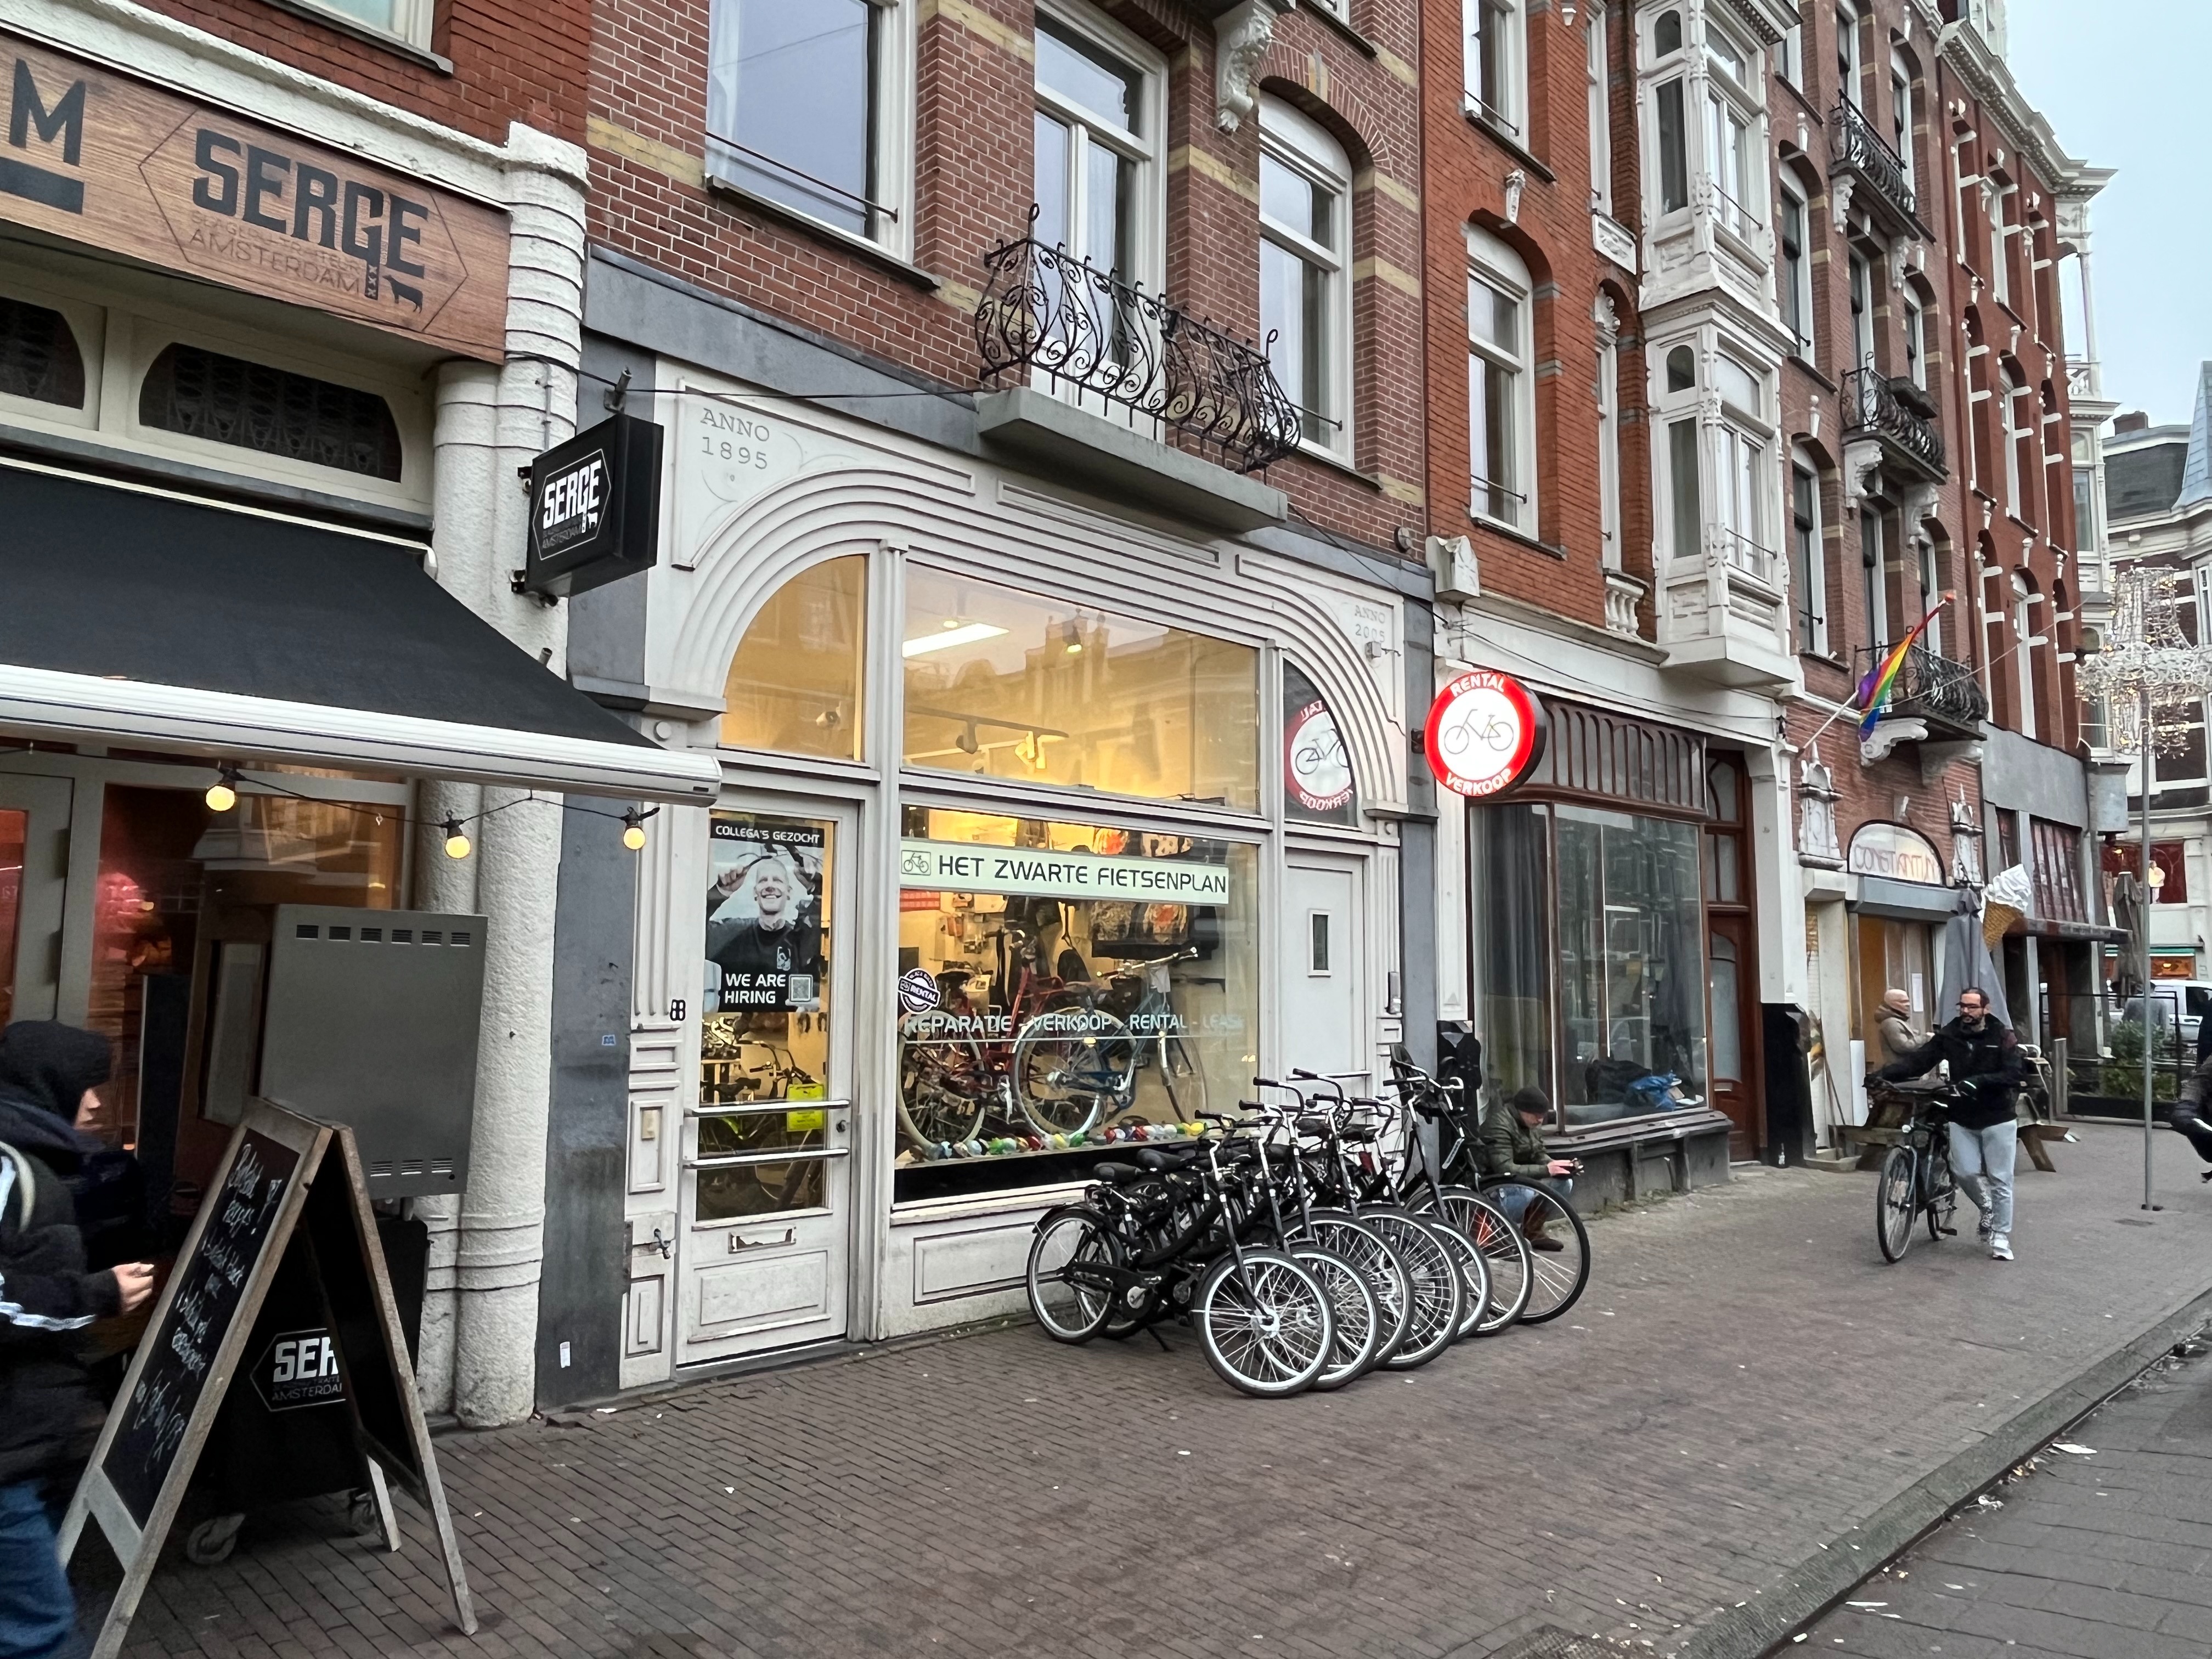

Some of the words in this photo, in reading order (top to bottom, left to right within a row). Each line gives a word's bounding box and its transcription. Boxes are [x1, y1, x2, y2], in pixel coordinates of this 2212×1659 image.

[193, 128, 428, 296] SERGE
[190, 228, 359, 294] AMSTERDAM
[700, 408, 770, 442] ANNO
[702, 437, 768, 470] 1895
[543, 459, 602, 531] SERGE
[1355, 605, 1385, 624] ANNO
[1450, 672, 1505, 697] RENTAL
[1446, 768, 1513, 797] VERKOOP
[715, 825, 769, 840] COLLEGA'S
[772, 831, 820, 844] GEZOCHT
[939, 855, 985, 877] HET
[995, 859, 1088, 884] ZWARTE
[1097, 867, 1226, 894] FIETSENPLAN
[725, 973, 751, 987] WE
[755, 973, 786, 988] ARE
[670, 999, 686, 1021] 88
[724, 990, 776, 1005] HIRING
[905, 1015, 1012, 1033] REPARATIE
[1034, 1014, 1112, 1032] VERKOOP
[1130, 1014, 1188, 1030] RENTAL
